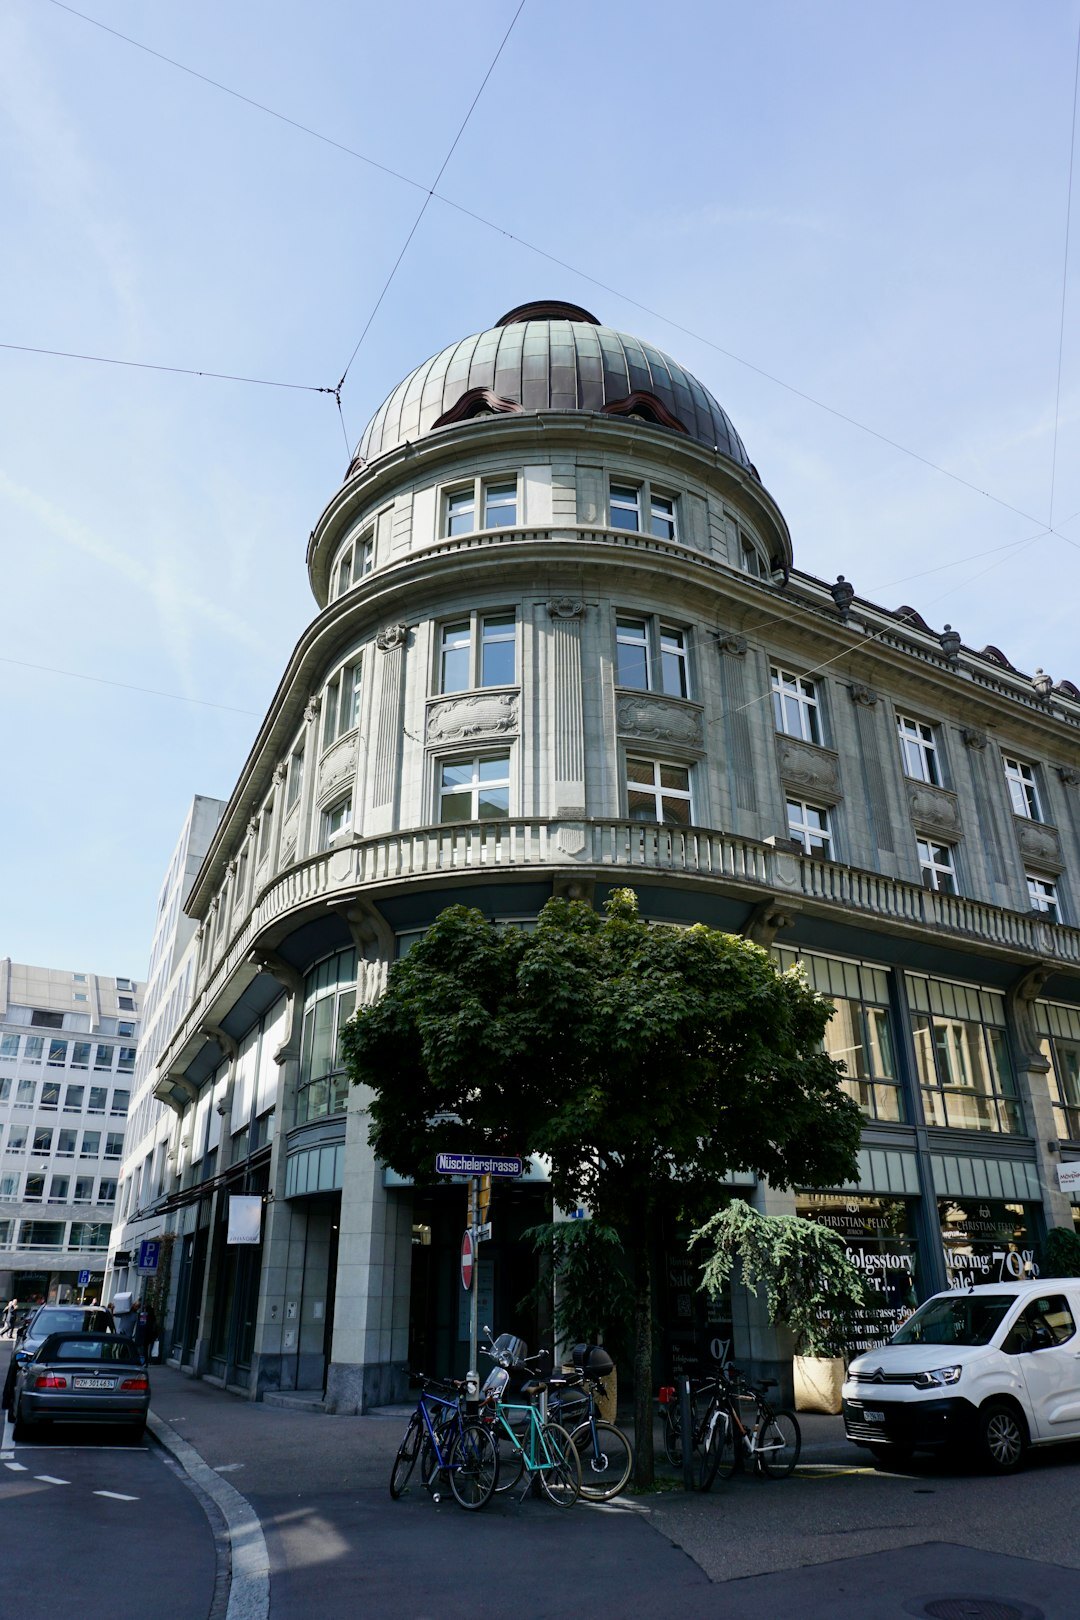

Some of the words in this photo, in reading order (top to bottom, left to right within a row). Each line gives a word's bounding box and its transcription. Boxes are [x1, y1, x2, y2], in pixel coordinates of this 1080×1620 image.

[439, 1155, 519, 1173] Nüschelerstrasse
[817, 1216, 865, 1228] CHRISTIAN
[868, 1218, 889, 1229] FELIX
[957, 1221, 996, 1232] CHRISTIAN
[998, 1222, 1015, 1232] FELIX
[146, 1243, 155, 1256] P
[846, 1247, 914, 1275] folgsstory
[943, 1248, 990, 1274] Moving
[992, 1250, 1040, 1283] 70%
[670, 1269, 694, 1288] Sale
